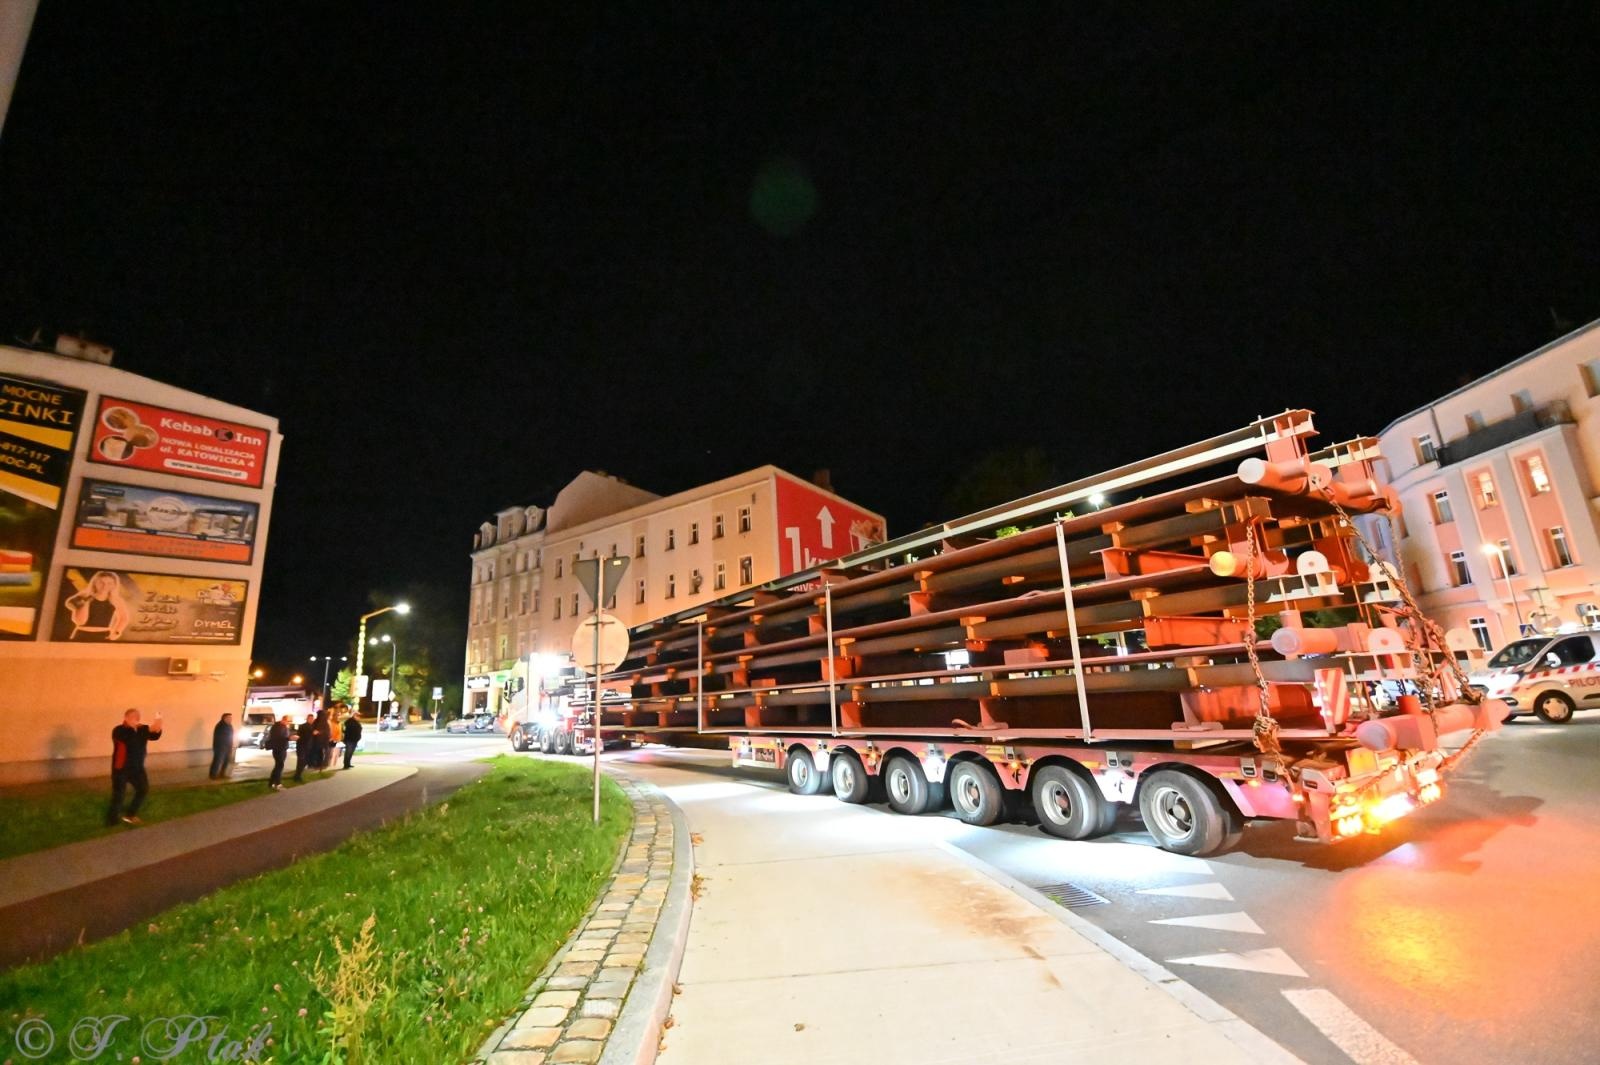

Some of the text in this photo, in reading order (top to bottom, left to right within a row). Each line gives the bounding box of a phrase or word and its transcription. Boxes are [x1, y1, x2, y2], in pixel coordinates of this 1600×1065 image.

[3, 384, 63, 405] MOCNE
[160, 417, 262, 447] Kebab Inn
[161, 437, 256, 460] NOWA LOKALIZACJA
[177, 448, 246, 467] KATOWICKA
[786, 527, 802, 574] 1
[193, 619, 236, 629] DYMEL
